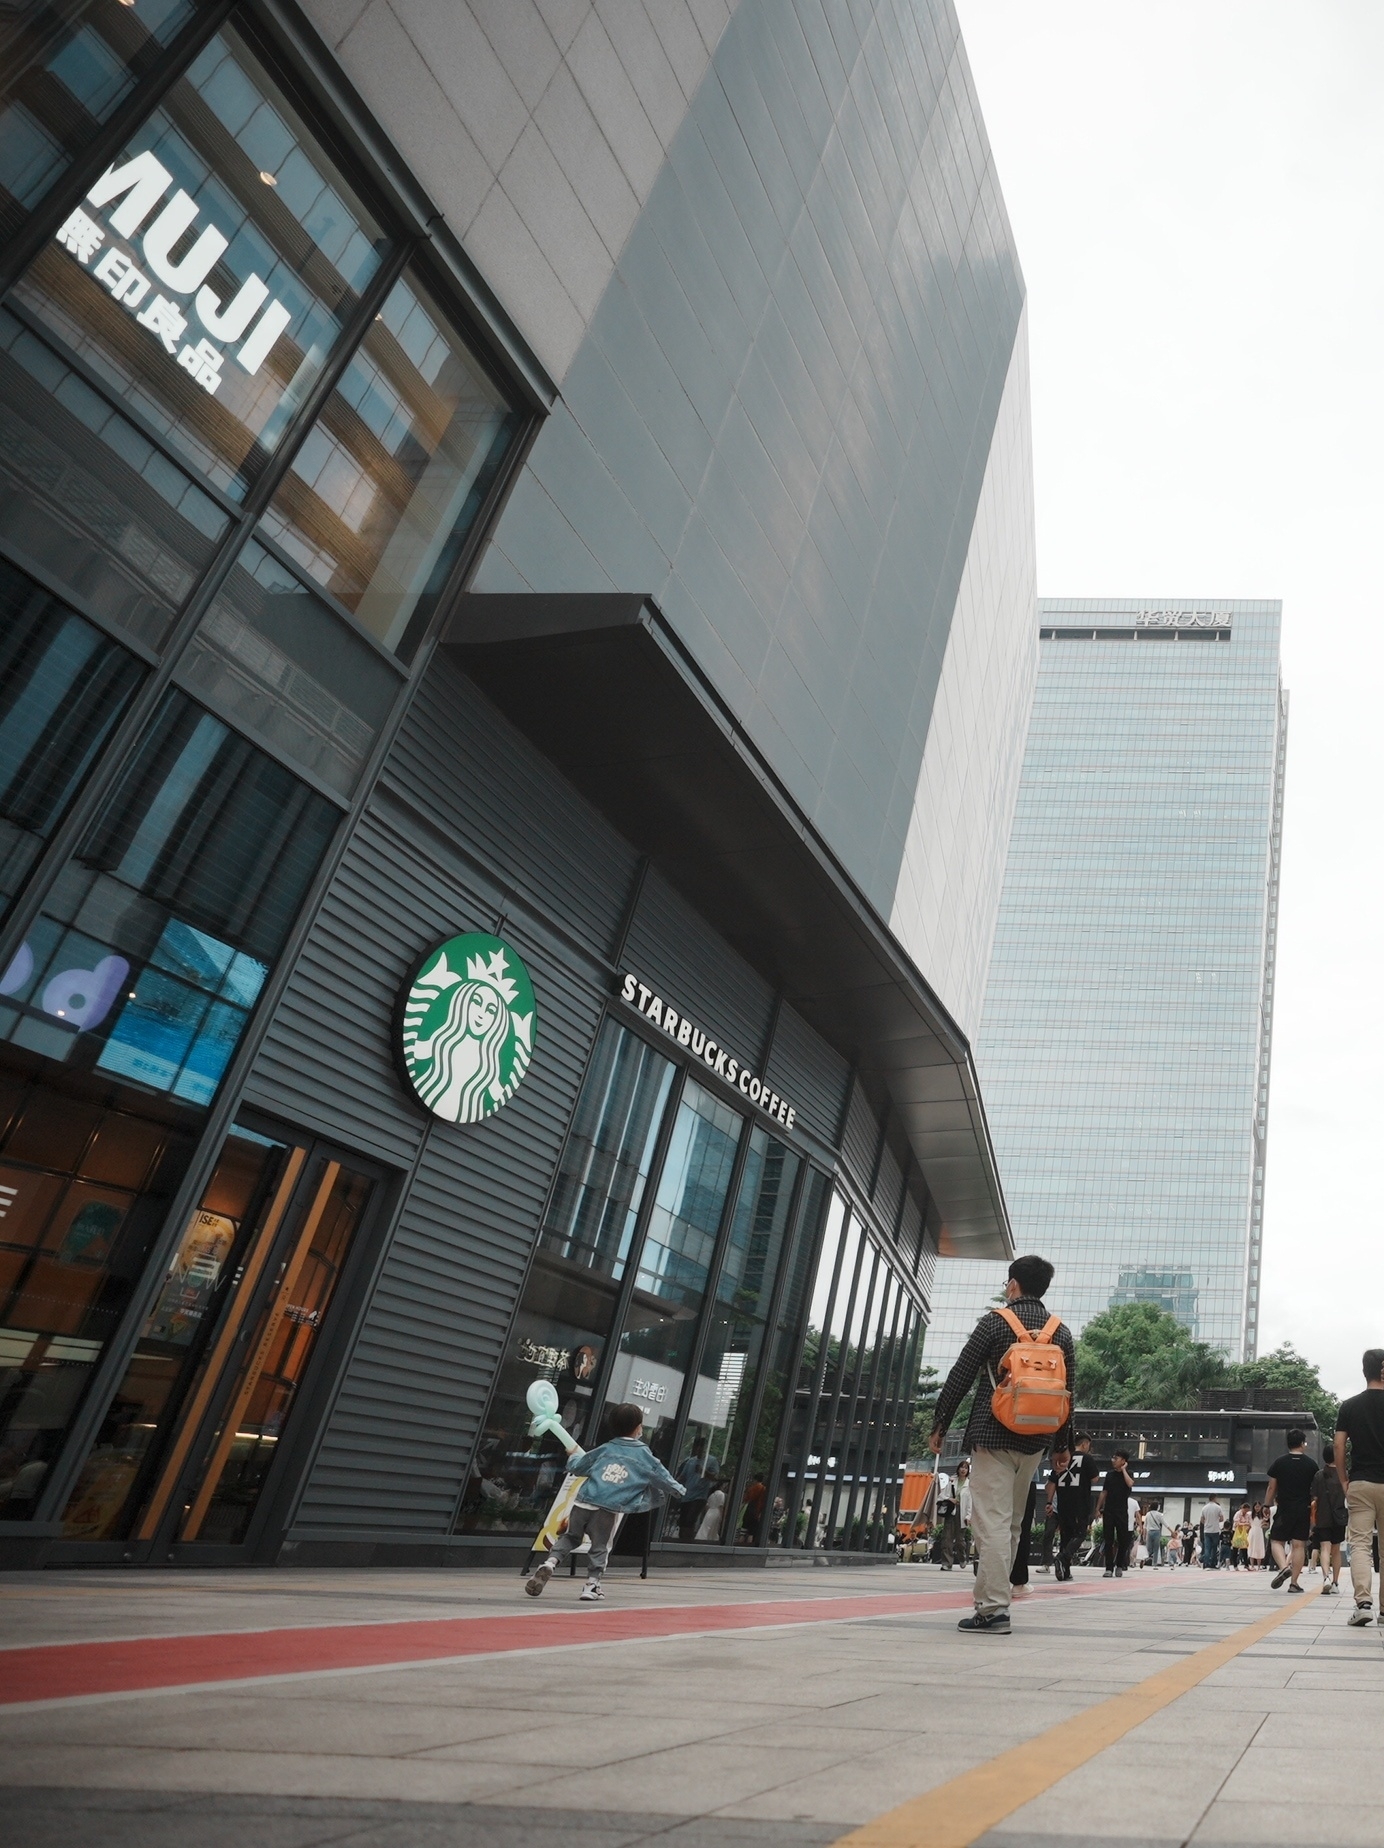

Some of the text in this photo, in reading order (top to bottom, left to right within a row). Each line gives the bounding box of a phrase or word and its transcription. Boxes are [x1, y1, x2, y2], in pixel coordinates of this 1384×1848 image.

[1135, 609, 1233, 628] 华贸大厦
[620, 973, 797, 1130] STARBUCKS COFFEE
